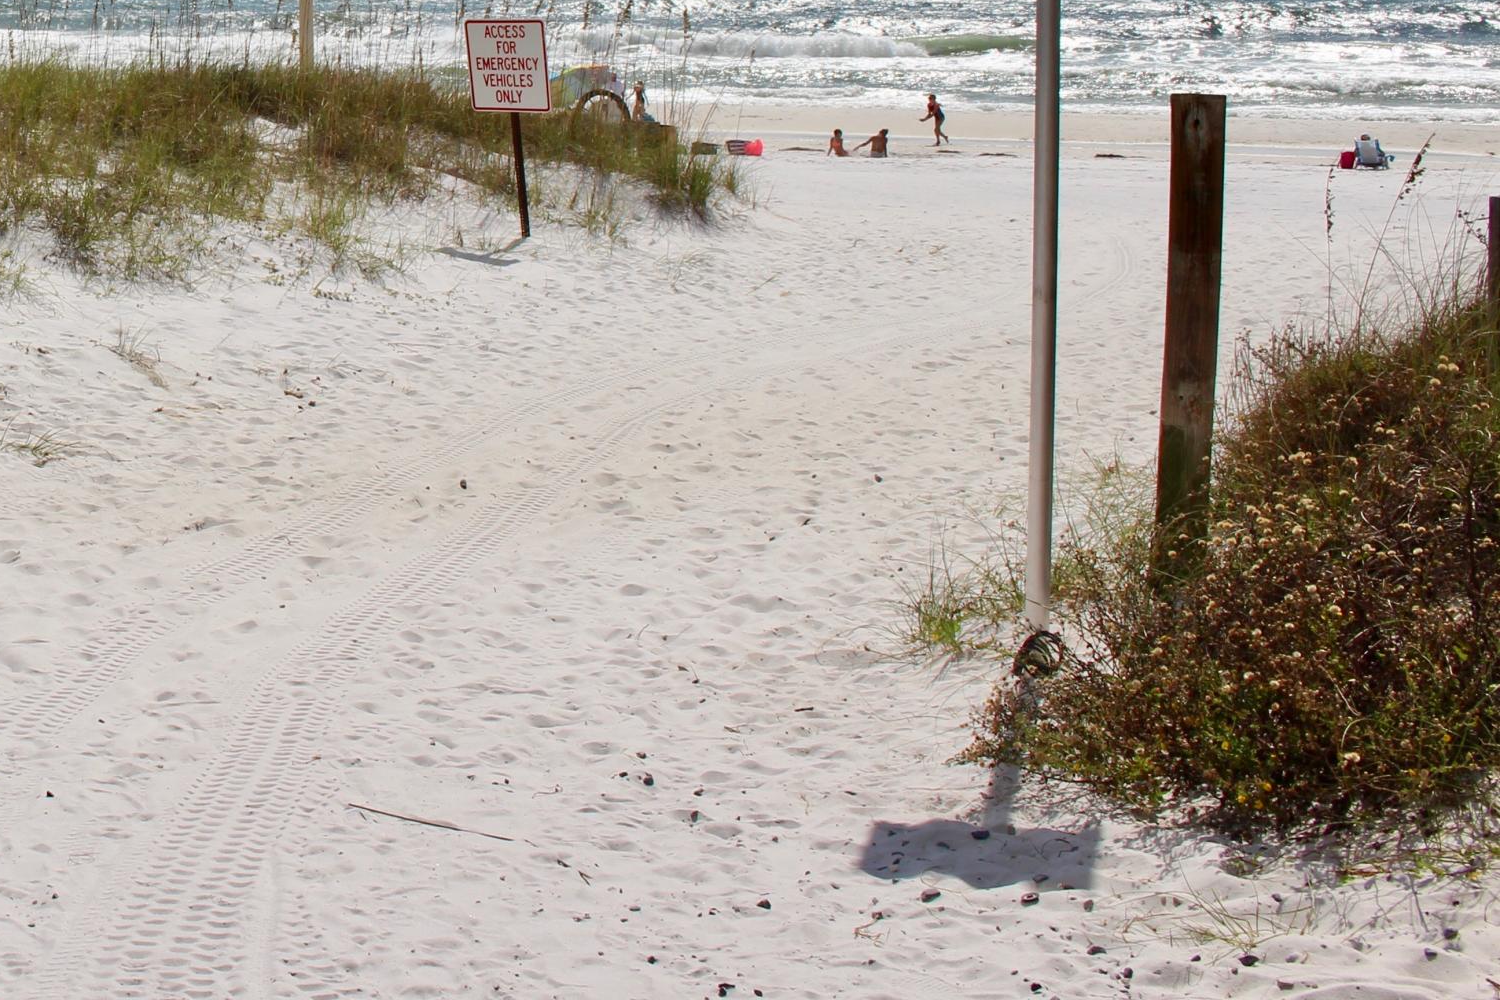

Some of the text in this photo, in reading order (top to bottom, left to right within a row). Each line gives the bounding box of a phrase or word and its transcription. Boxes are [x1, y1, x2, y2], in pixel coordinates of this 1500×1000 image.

[485, 25, 525, 38] ACCESS
[497, 41, 516, 54] FOR
[476, 57, 538, 70] EMERGENCY
[483, 74, 533, 87] VEHICLES
[496, 90, 522, 103] ONLY
